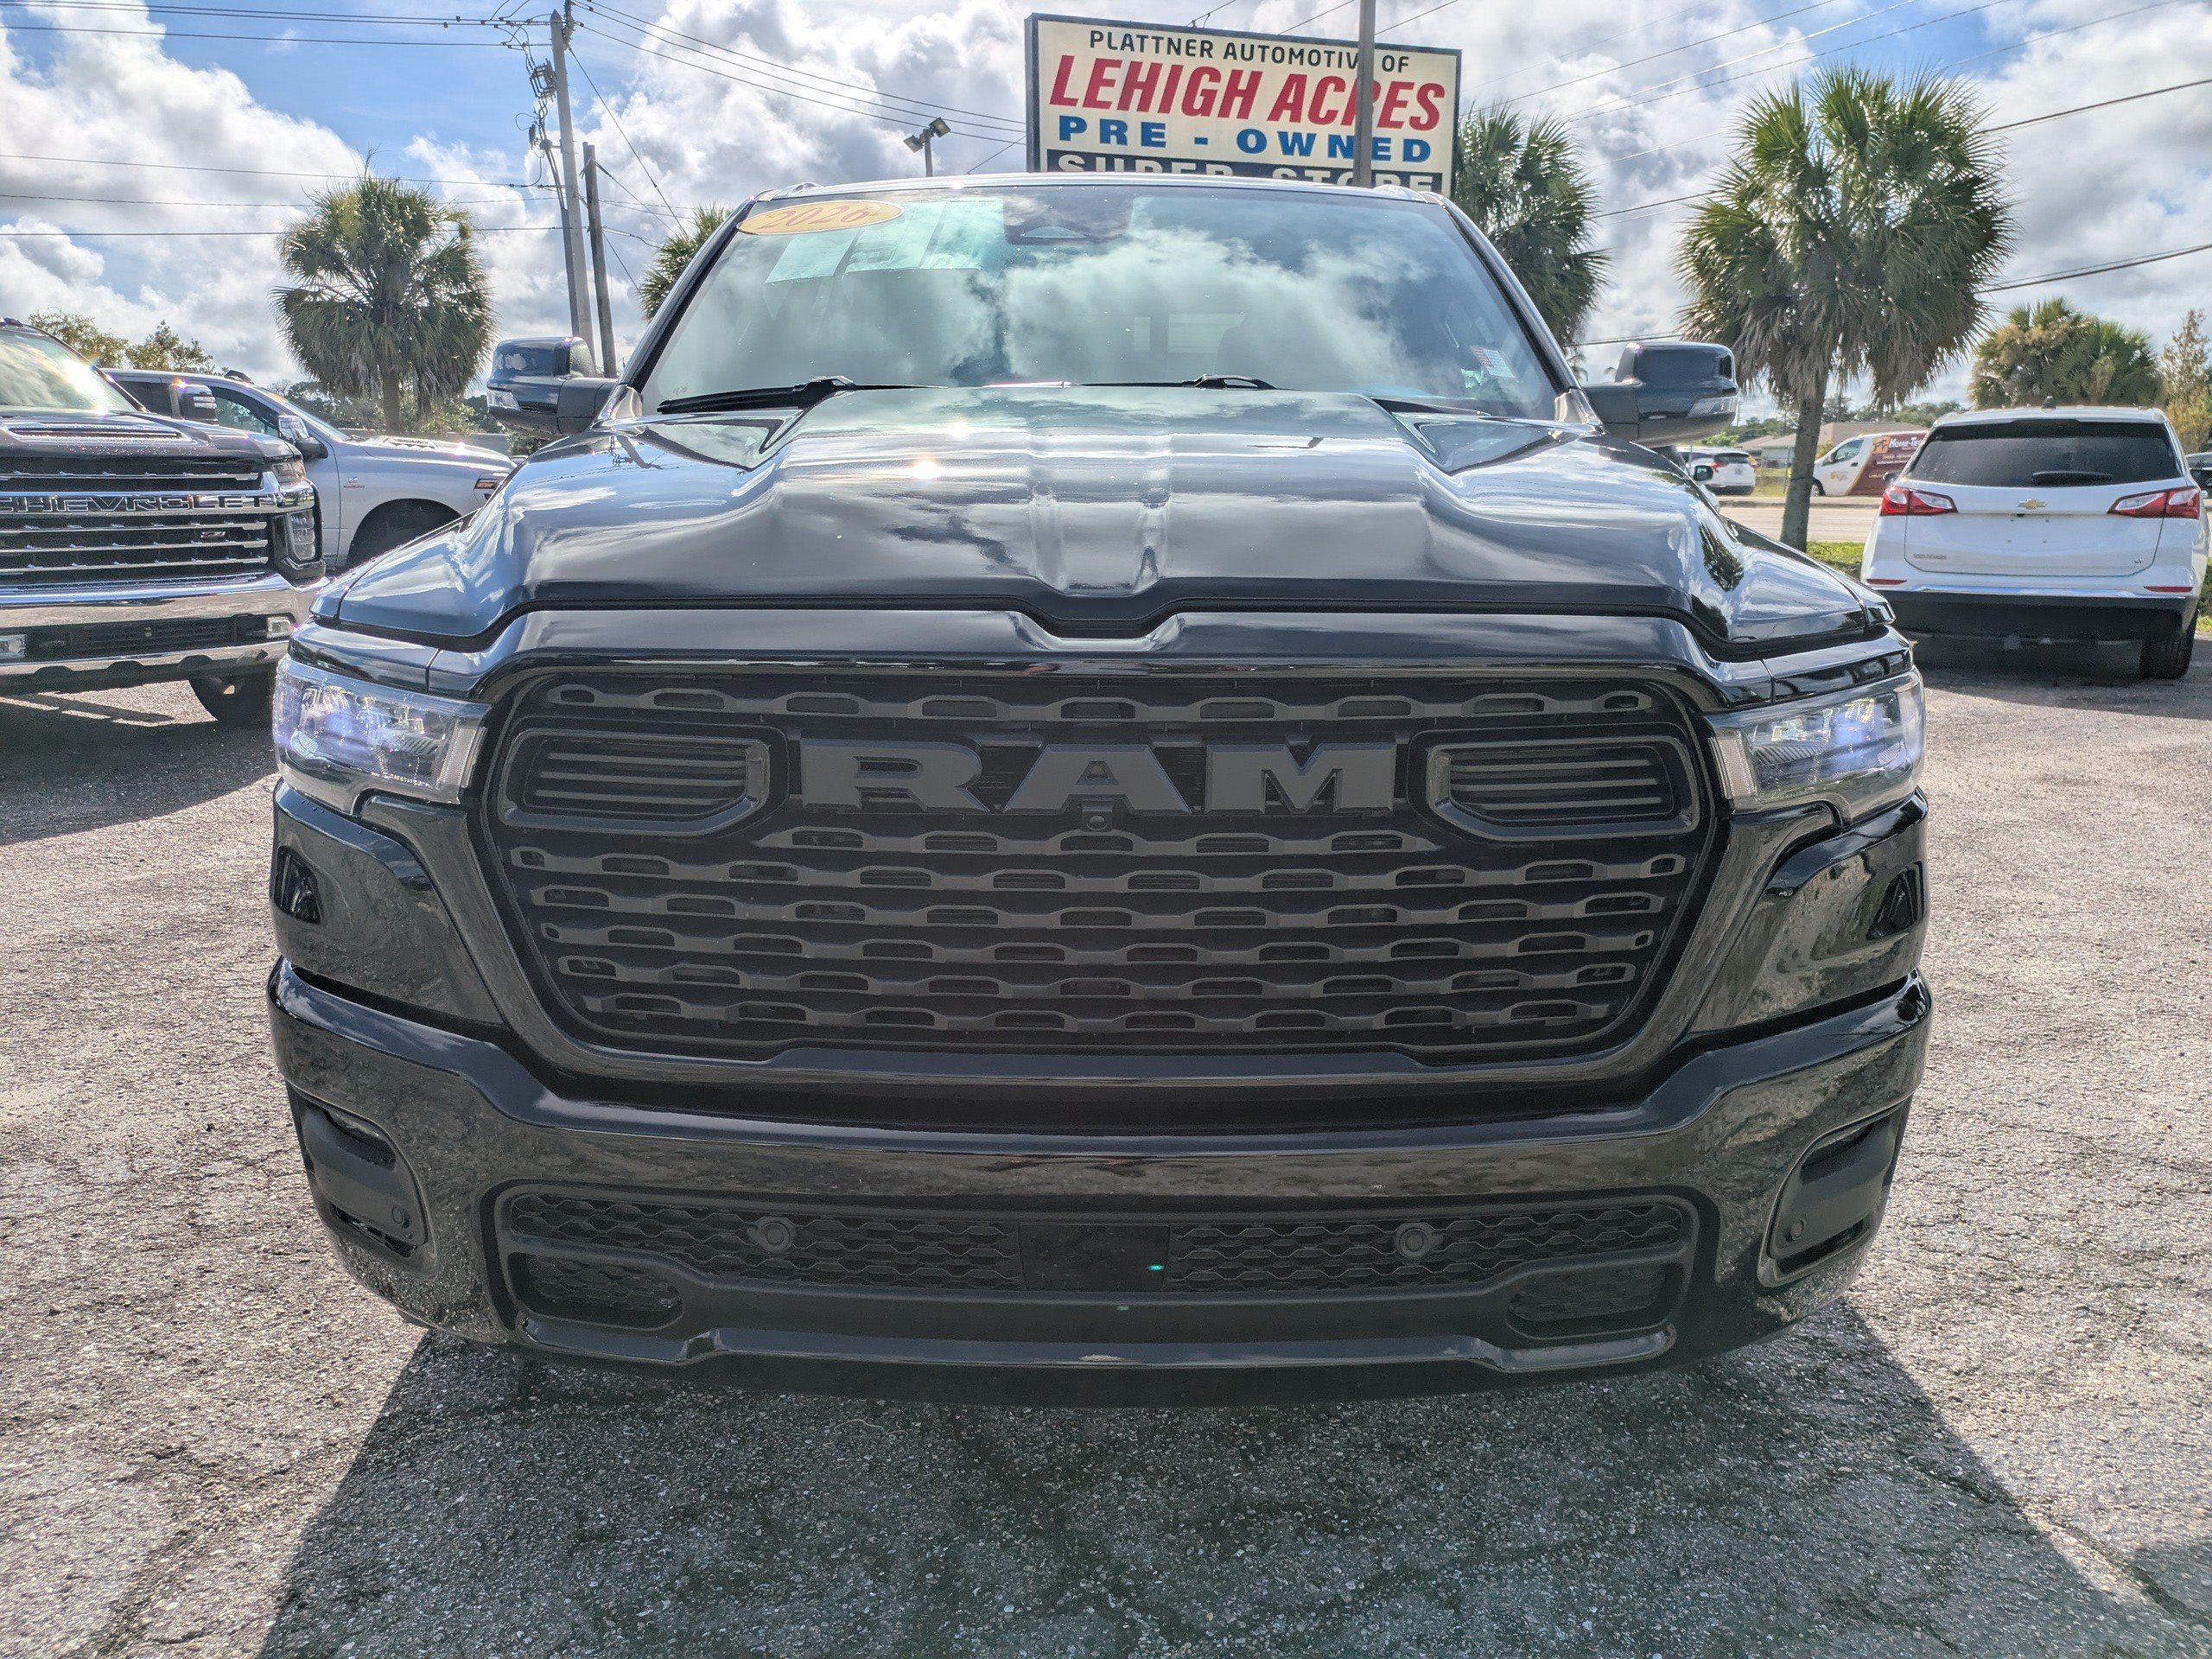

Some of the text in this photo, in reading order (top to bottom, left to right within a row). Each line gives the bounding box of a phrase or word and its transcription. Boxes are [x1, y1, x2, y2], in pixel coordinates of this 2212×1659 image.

[1090, 29, 1409, 73] PLATTNER AUTOMOTIV OF
[1049, 54, 1446, 131] LEHIGH ACRES
[1058, 115, 1166, 149] PRE
[1236, 129, 1432, 163] OWNED
[800, 736, 1397, 815] RAM
